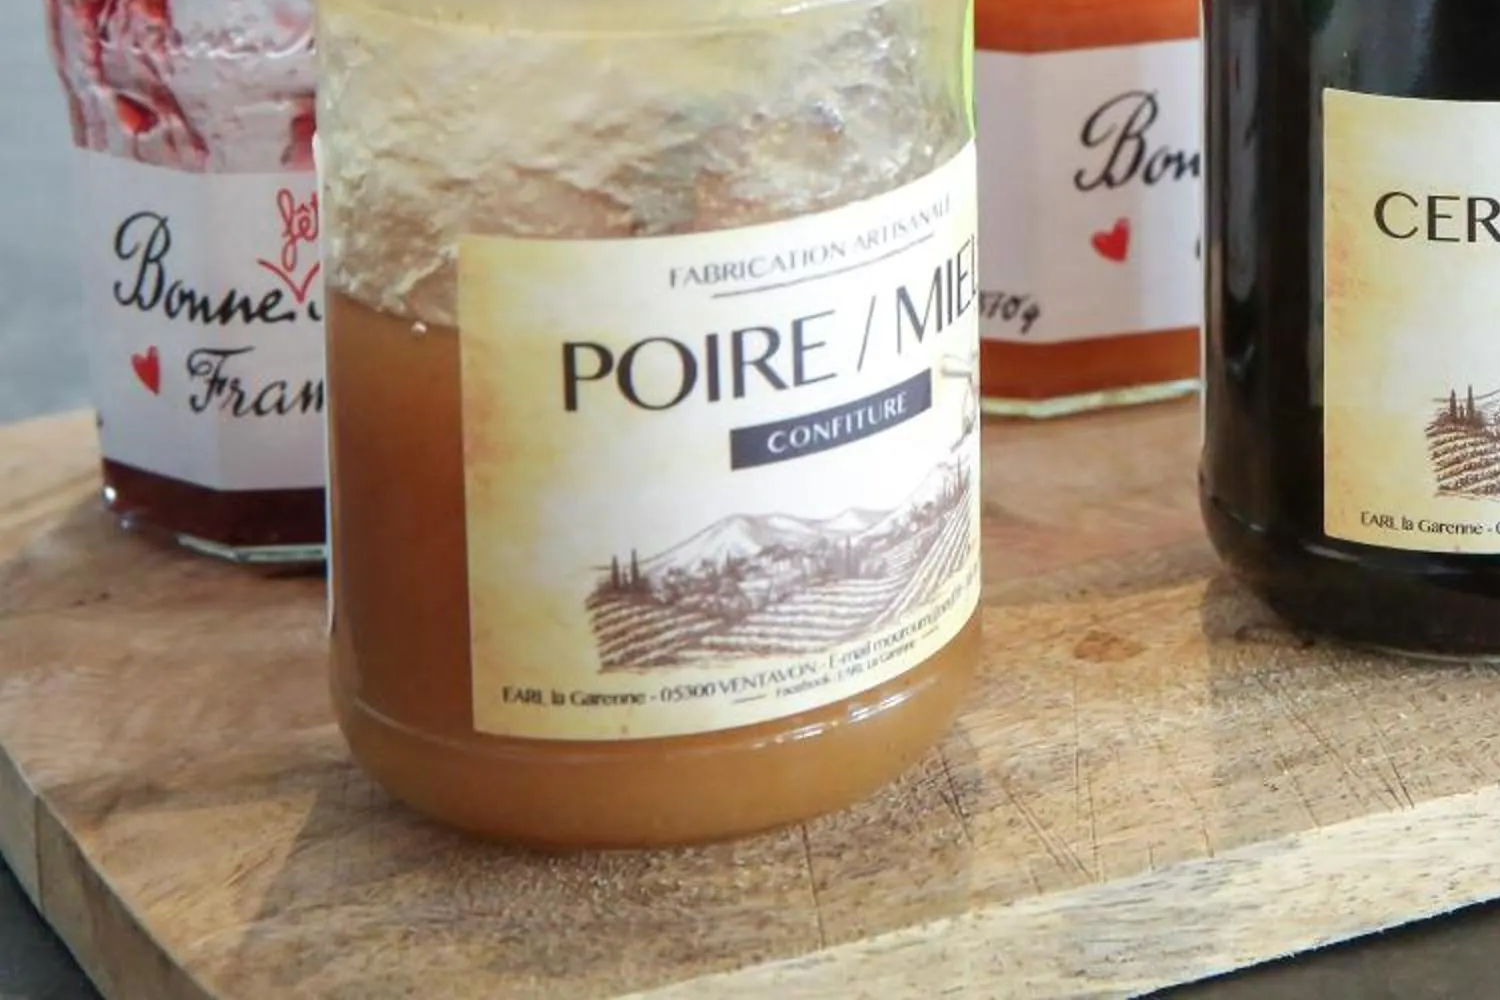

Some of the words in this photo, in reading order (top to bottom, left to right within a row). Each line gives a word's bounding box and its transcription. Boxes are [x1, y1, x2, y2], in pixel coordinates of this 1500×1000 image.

[113, 211, 297, 325] Bonne
[669, 240, 847, 289] FABRICATION
[562, 310, 837, 412] POIRE
[857, 295, 877, 373] /
[767, 391, 907, 454] CONFITURE
[1361, 511, 1398, 529] EARL
[1402, 516, 1414, 530] la
[1418, 517, 1482, 535] Garenne
[502, 686, 543, 706] EARL
[570, 689, 646, 708] Garenne
[660, 681, 716, 704] 05300
[718, 660, 817, 694] VENTAVON
